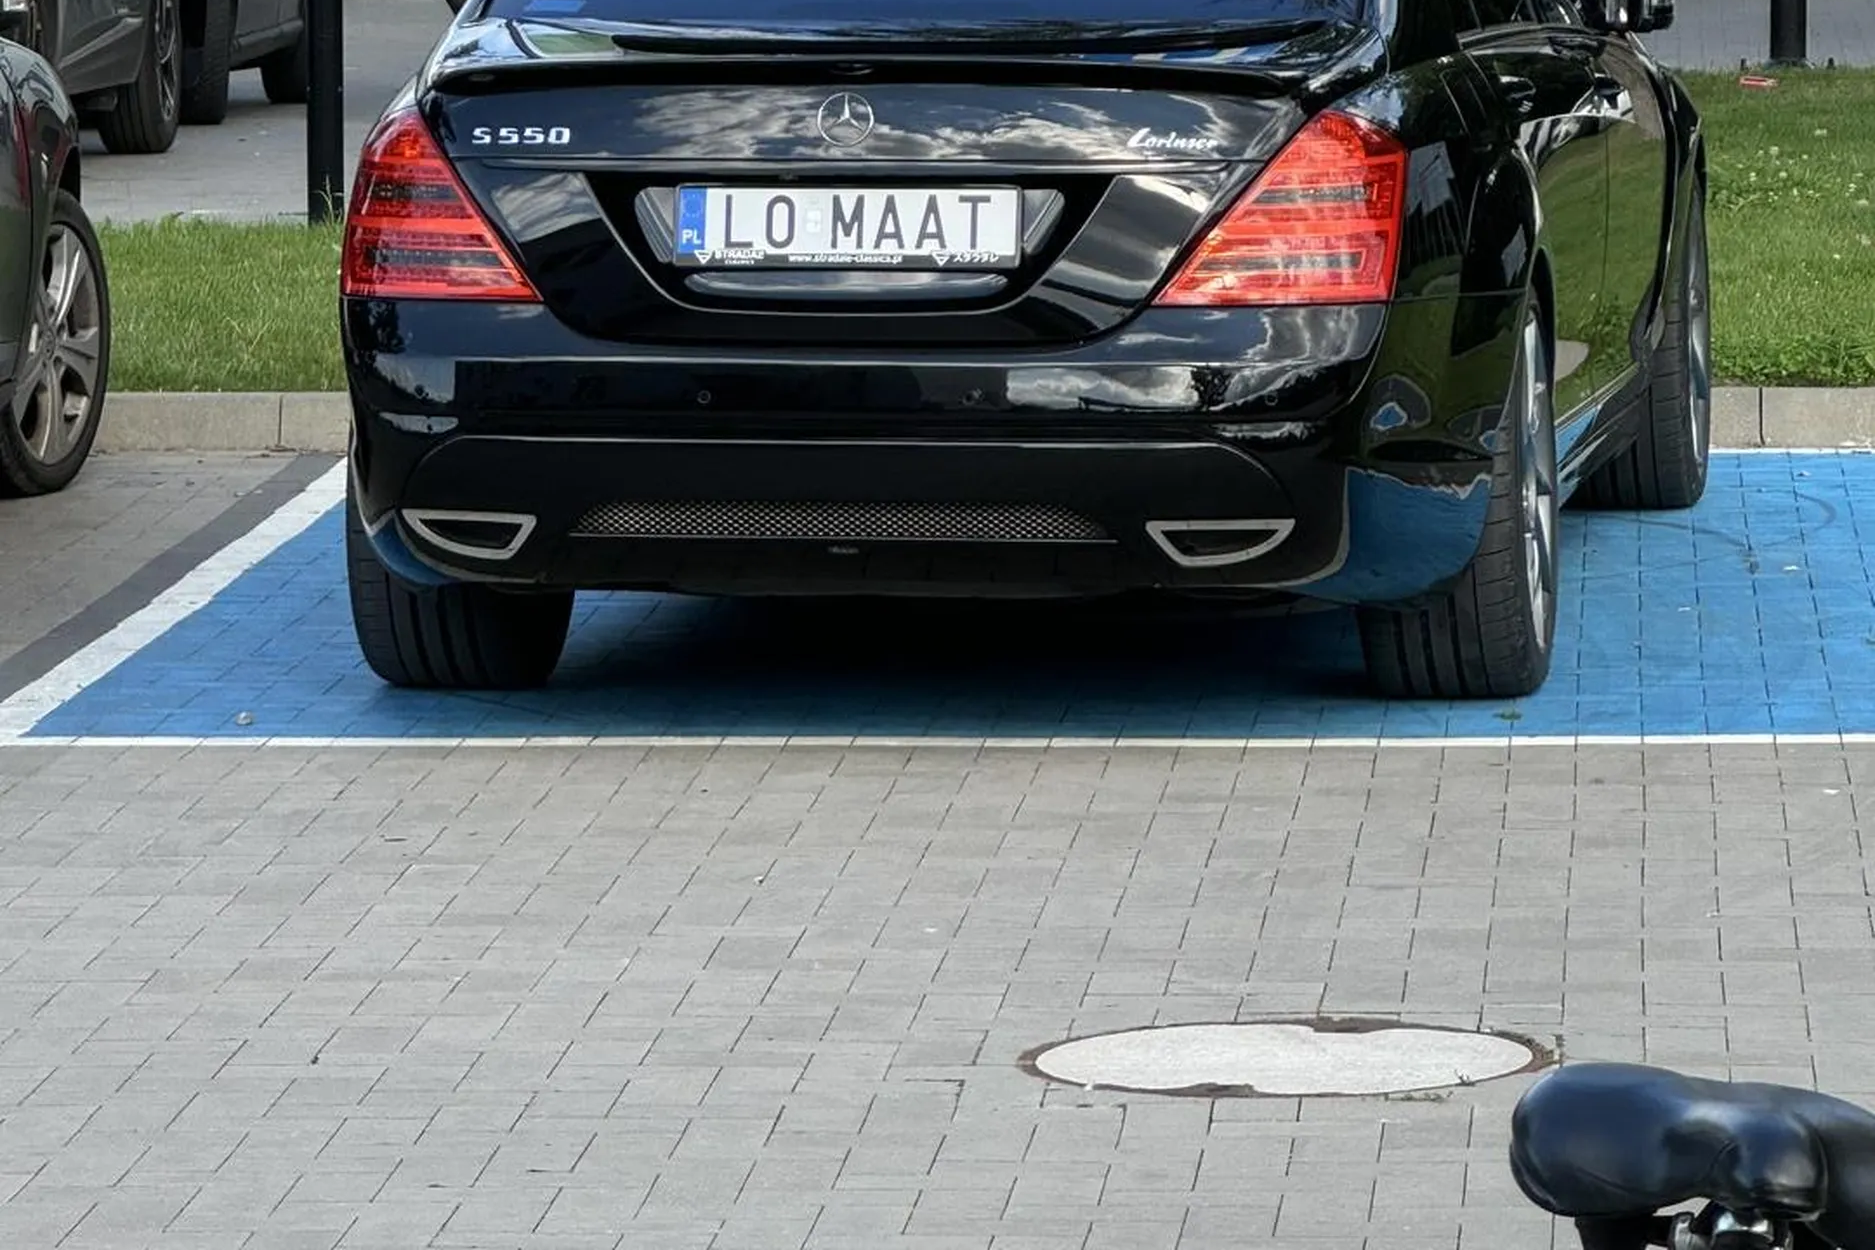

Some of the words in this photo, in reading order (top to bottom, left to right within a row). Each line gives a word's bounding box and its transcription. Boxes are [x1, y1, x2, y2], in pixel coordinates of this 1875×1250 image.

[472, 127, 491, 144] S
[498, 127, 570, 144] 550
[724, 194, 796, 249] LO
[831, 194, 991, 250] MAAT
[682, 229, 701, 244] PL
